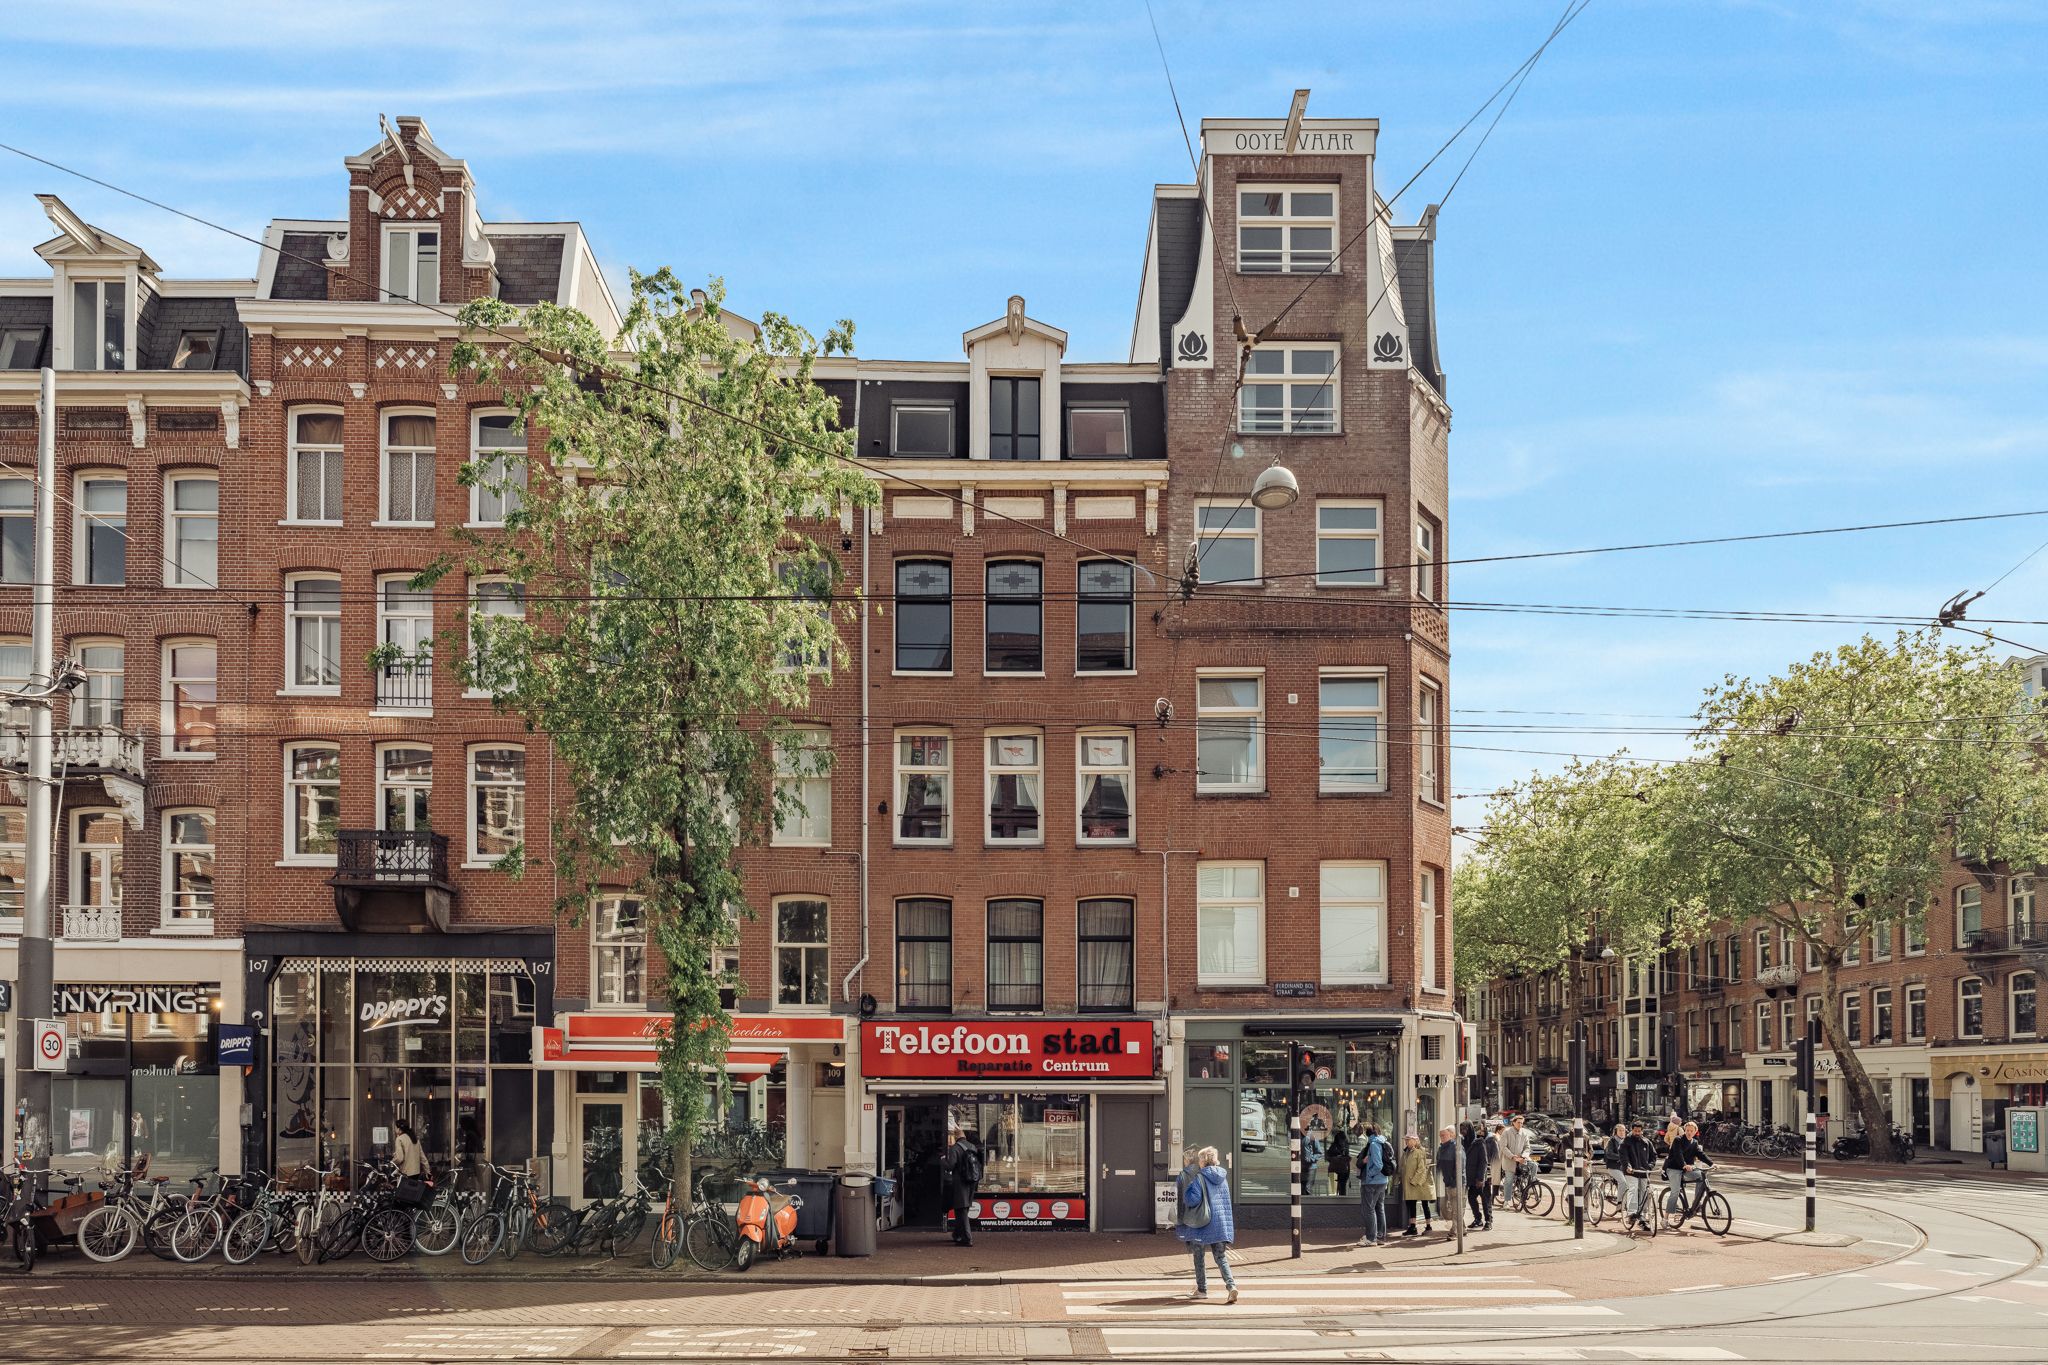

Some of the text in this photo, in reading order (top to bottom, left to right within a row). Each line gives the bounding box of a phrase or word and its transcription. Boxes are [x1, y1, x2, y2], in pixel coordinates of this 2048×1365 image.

[249, 959, 268, 973] 107
[532, 961, 551, 975] 107
[360, 994, 447, 1021] DRIPPY'S
[724, 1020, 784, 1037] hocolatier
[45, 1039, 59, 1051] 30
[220, 1035, 251, 1050] DRIPPY'S
[876, 1026, 1031, 1055] Telefoon
[828, 1068, 841, 1078] 109
[957, 1059, 1110, 1076] Reparatie Centrum
[1048, 1115, 1074, 1123] OPEN
[980, 1219, 1053, 1227] www.telefoonstad.com
